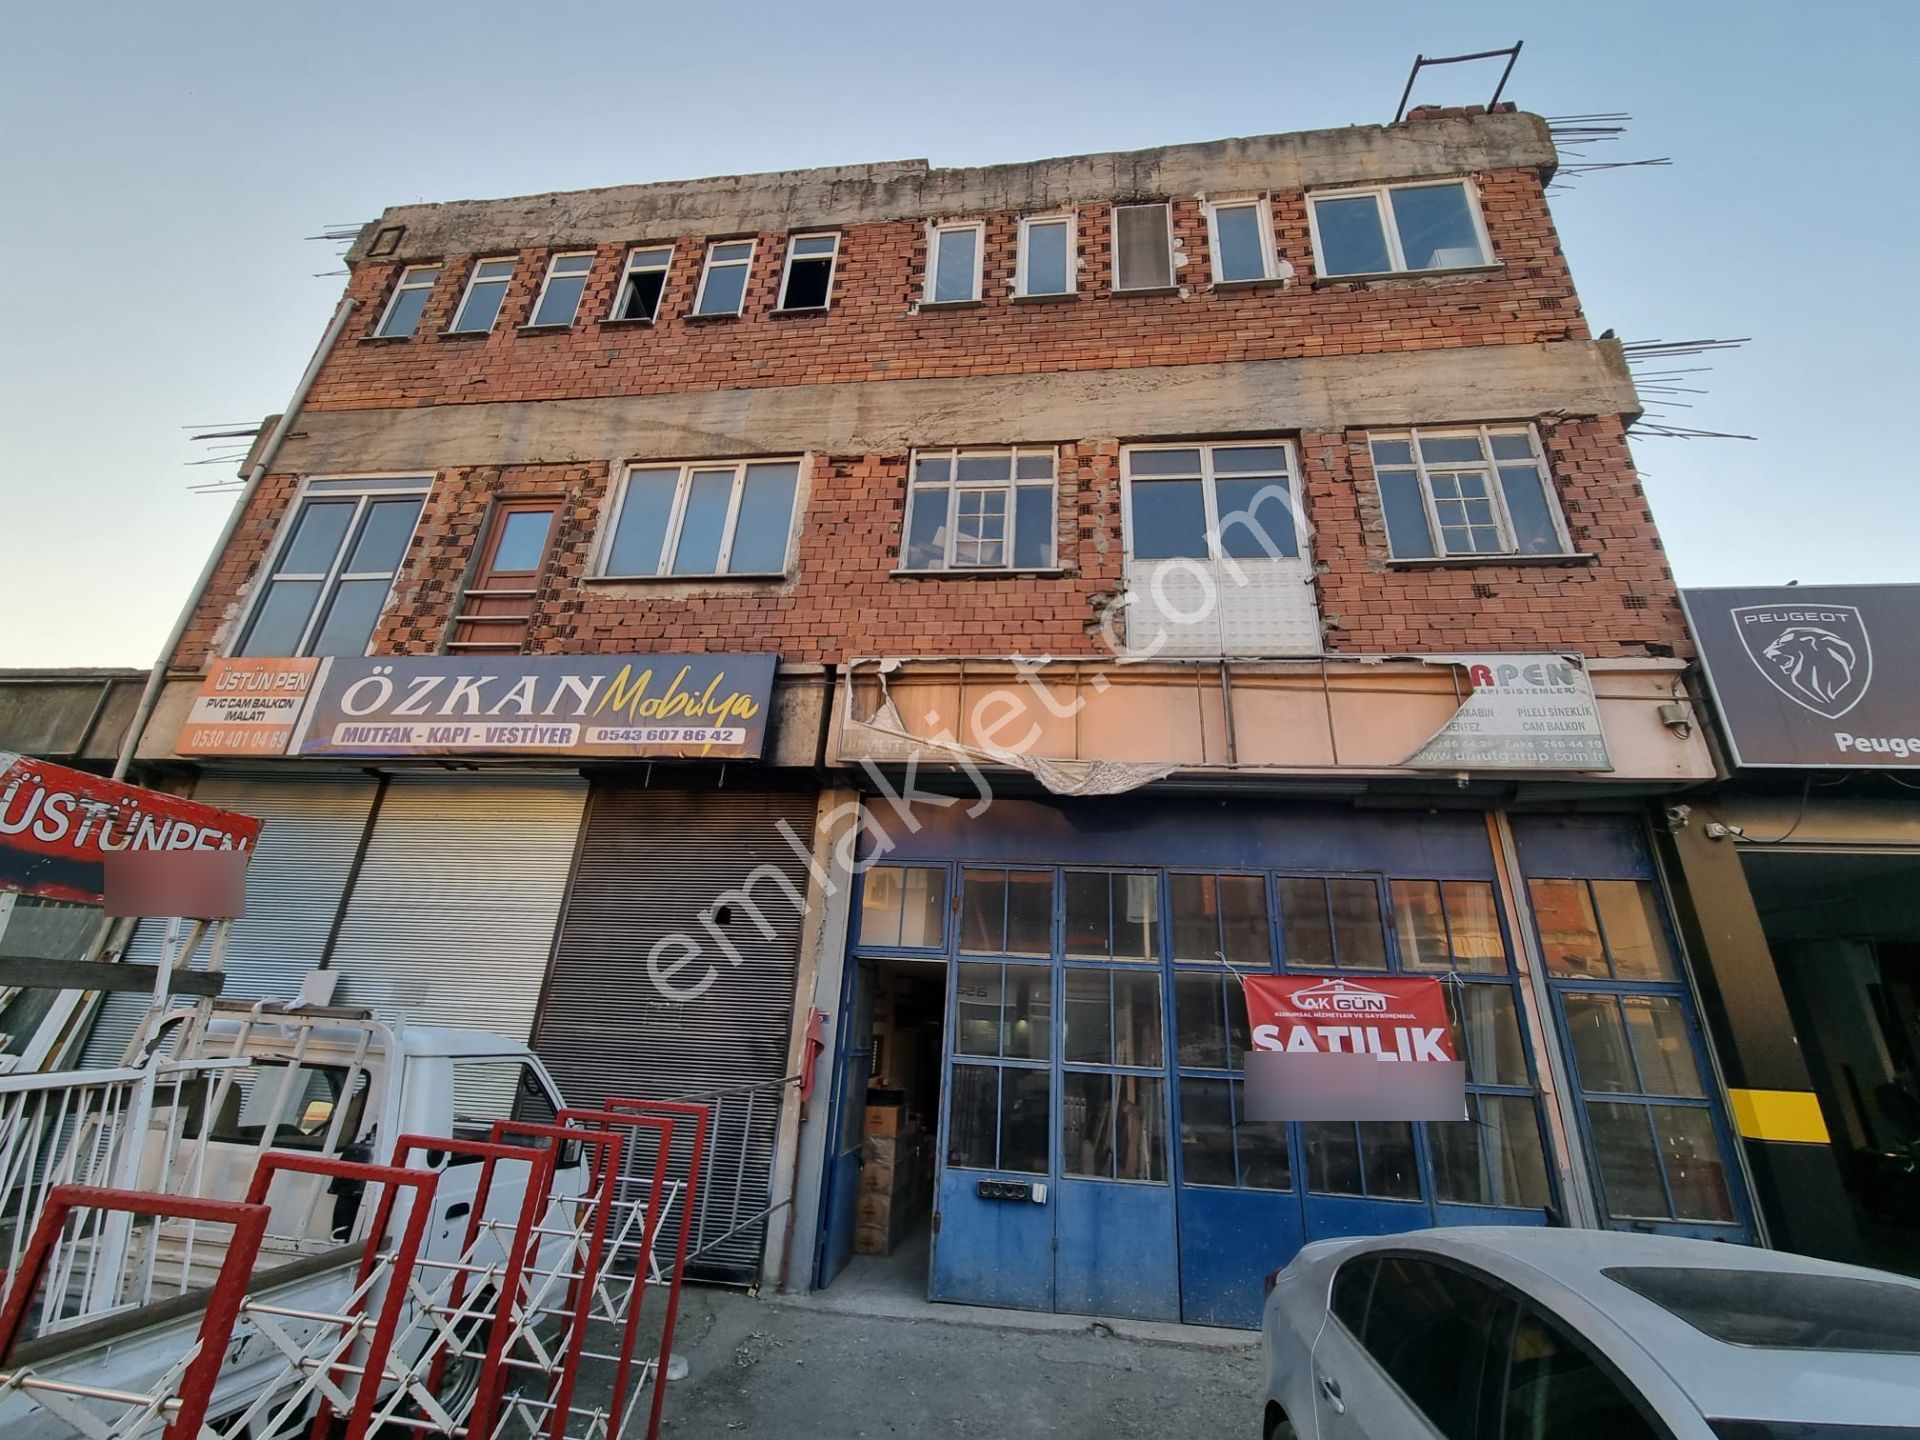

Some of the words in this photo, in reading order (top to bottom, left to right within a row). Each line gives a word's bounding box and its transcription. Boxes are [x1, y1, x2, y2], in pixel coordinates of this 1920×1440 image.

[1744, 612, 1849, 624] PEUGEOT
[215, 666, 274, 691] ÜSTÜN
[274, 672, 310, 690] PEN
[206, 698, 230, 709] PVC
[228, 699, 251, 708] CAM
[252, 699, 295, 708] BALKON
[340, 665, 606, 716] ÖZKAN
[593, 664, 759, 757] Mobilya
[341, 727, 414, 743] MUTFAK
[426, 727, 472, 743] KAPI
[485, 725, 573, 744] VESTİYER
[1522, 722, 1545, 731] CAM
[1547, 721, 1587, 731] BALKON
[191, 730, 223, 748] 0530
[225, 731, 249, 747] 401
[251, 731, 267, 747] 04
[597, 729, 642, 741] 0543
[646, 730, 680, 741] 607
[682, 730, 706, 741] 86
[710, 730, 734, 742] 42
[1252, 1024, 1450, 1061] SATILIK
